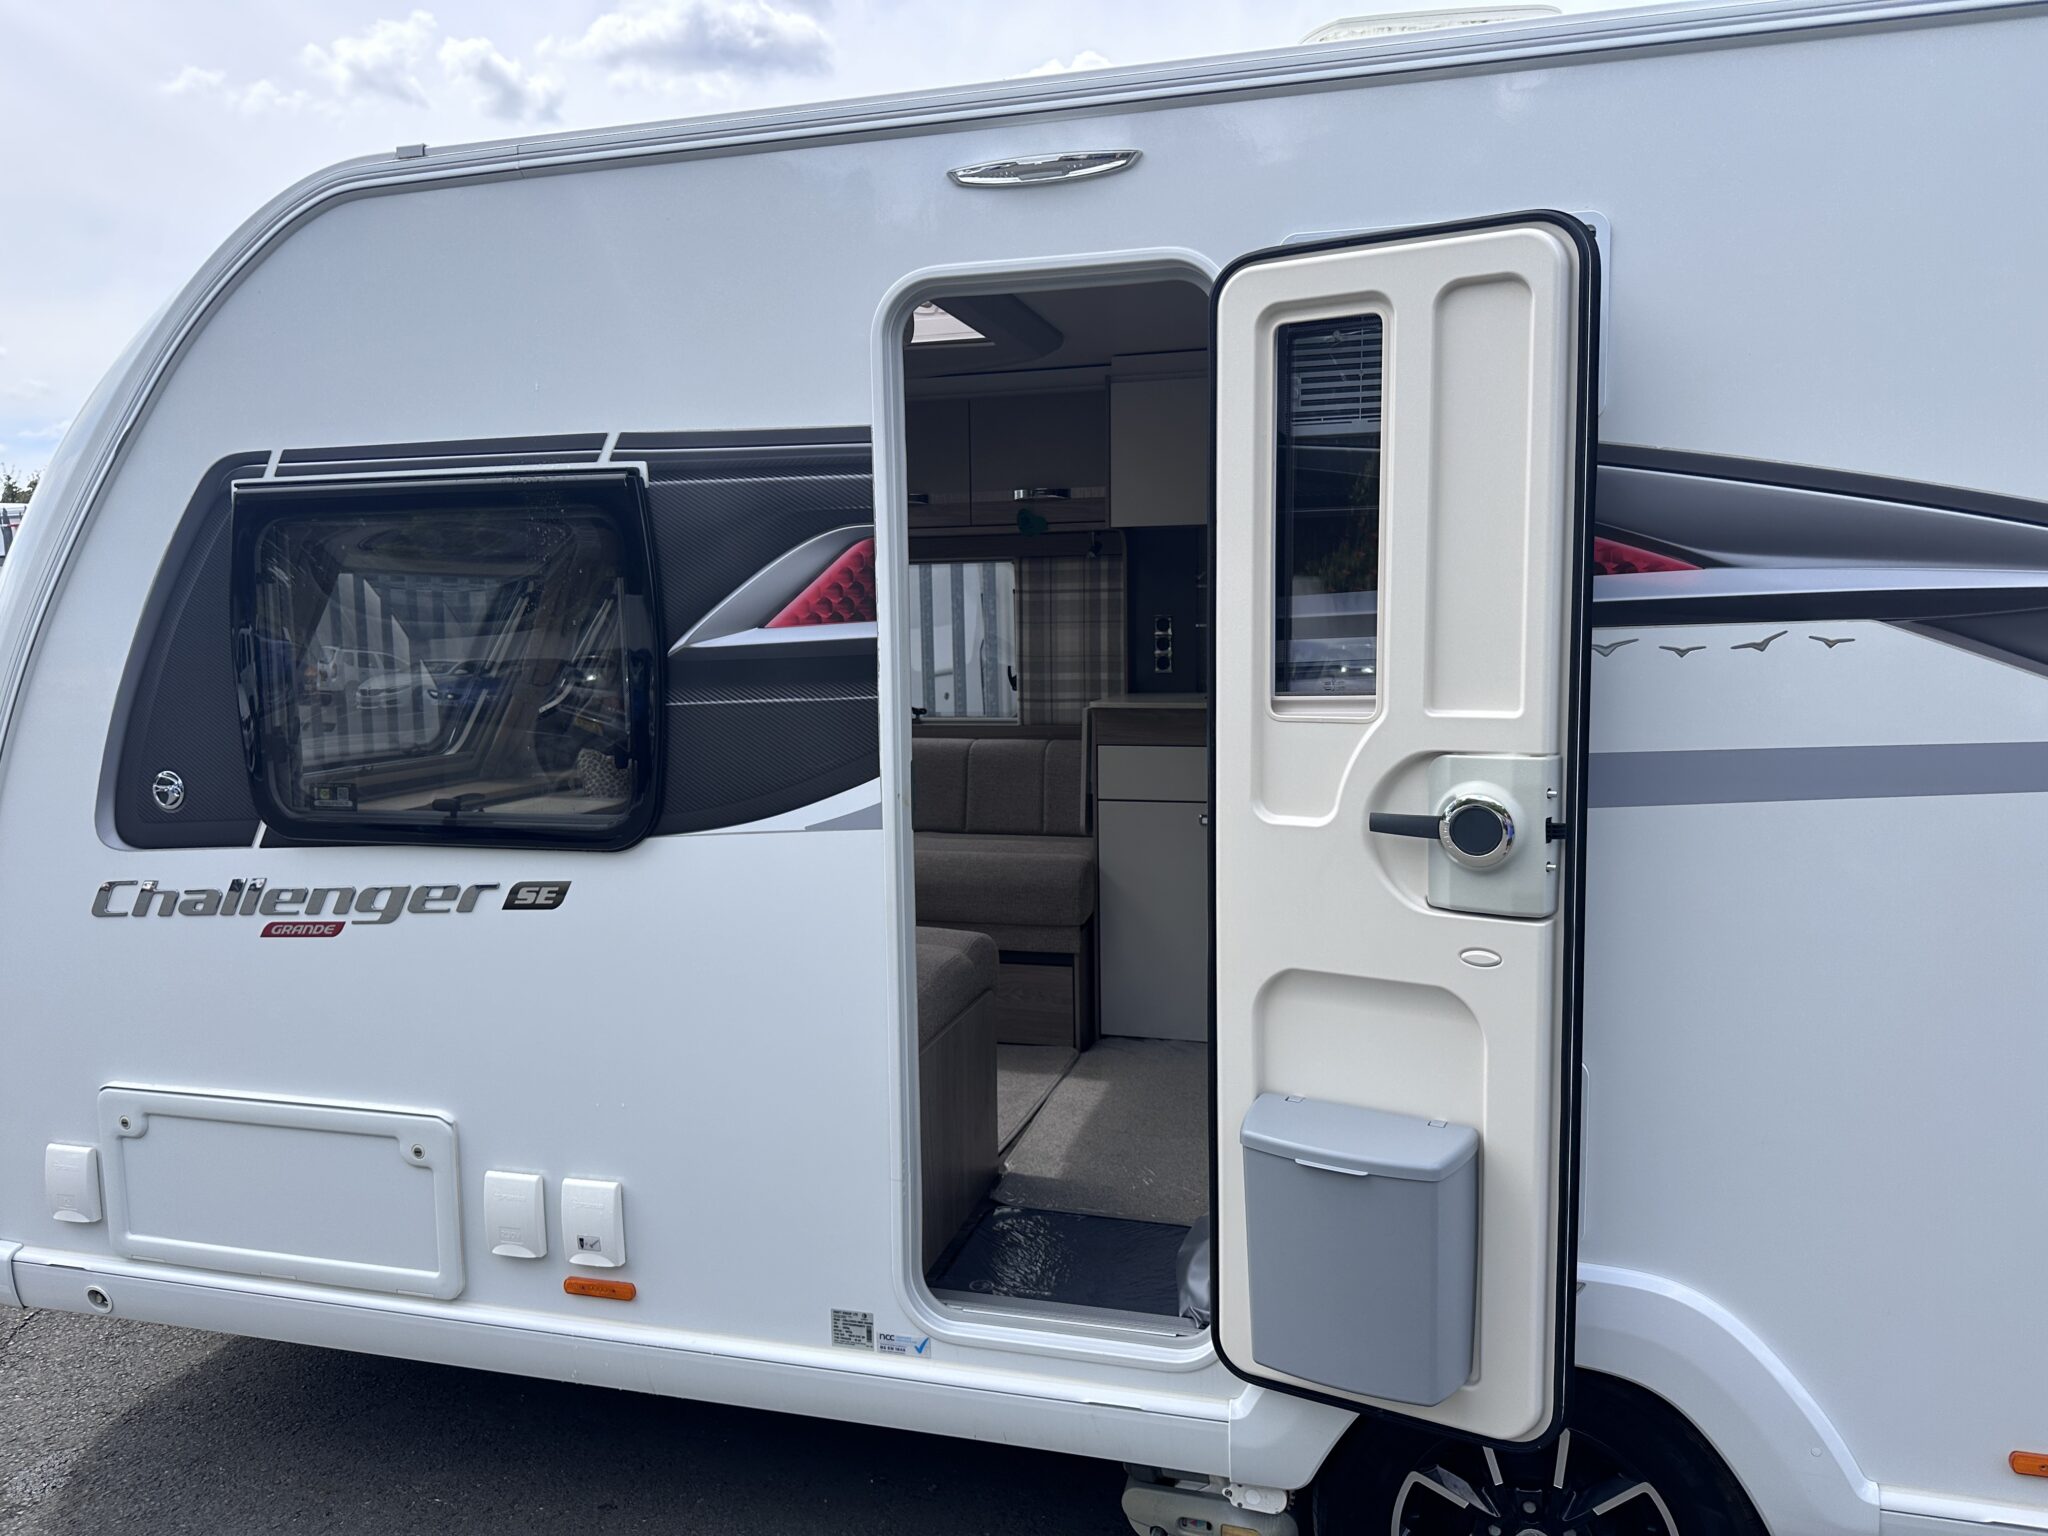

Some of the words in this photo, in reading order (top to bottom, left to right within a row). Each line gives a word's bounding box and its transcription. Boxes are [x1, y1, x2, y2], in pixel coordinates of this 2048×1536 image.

[91, 877, 501, 925] Challenger
[513, 886, 557, 905] SE
[270, 924, 336, 936] GRANDE
